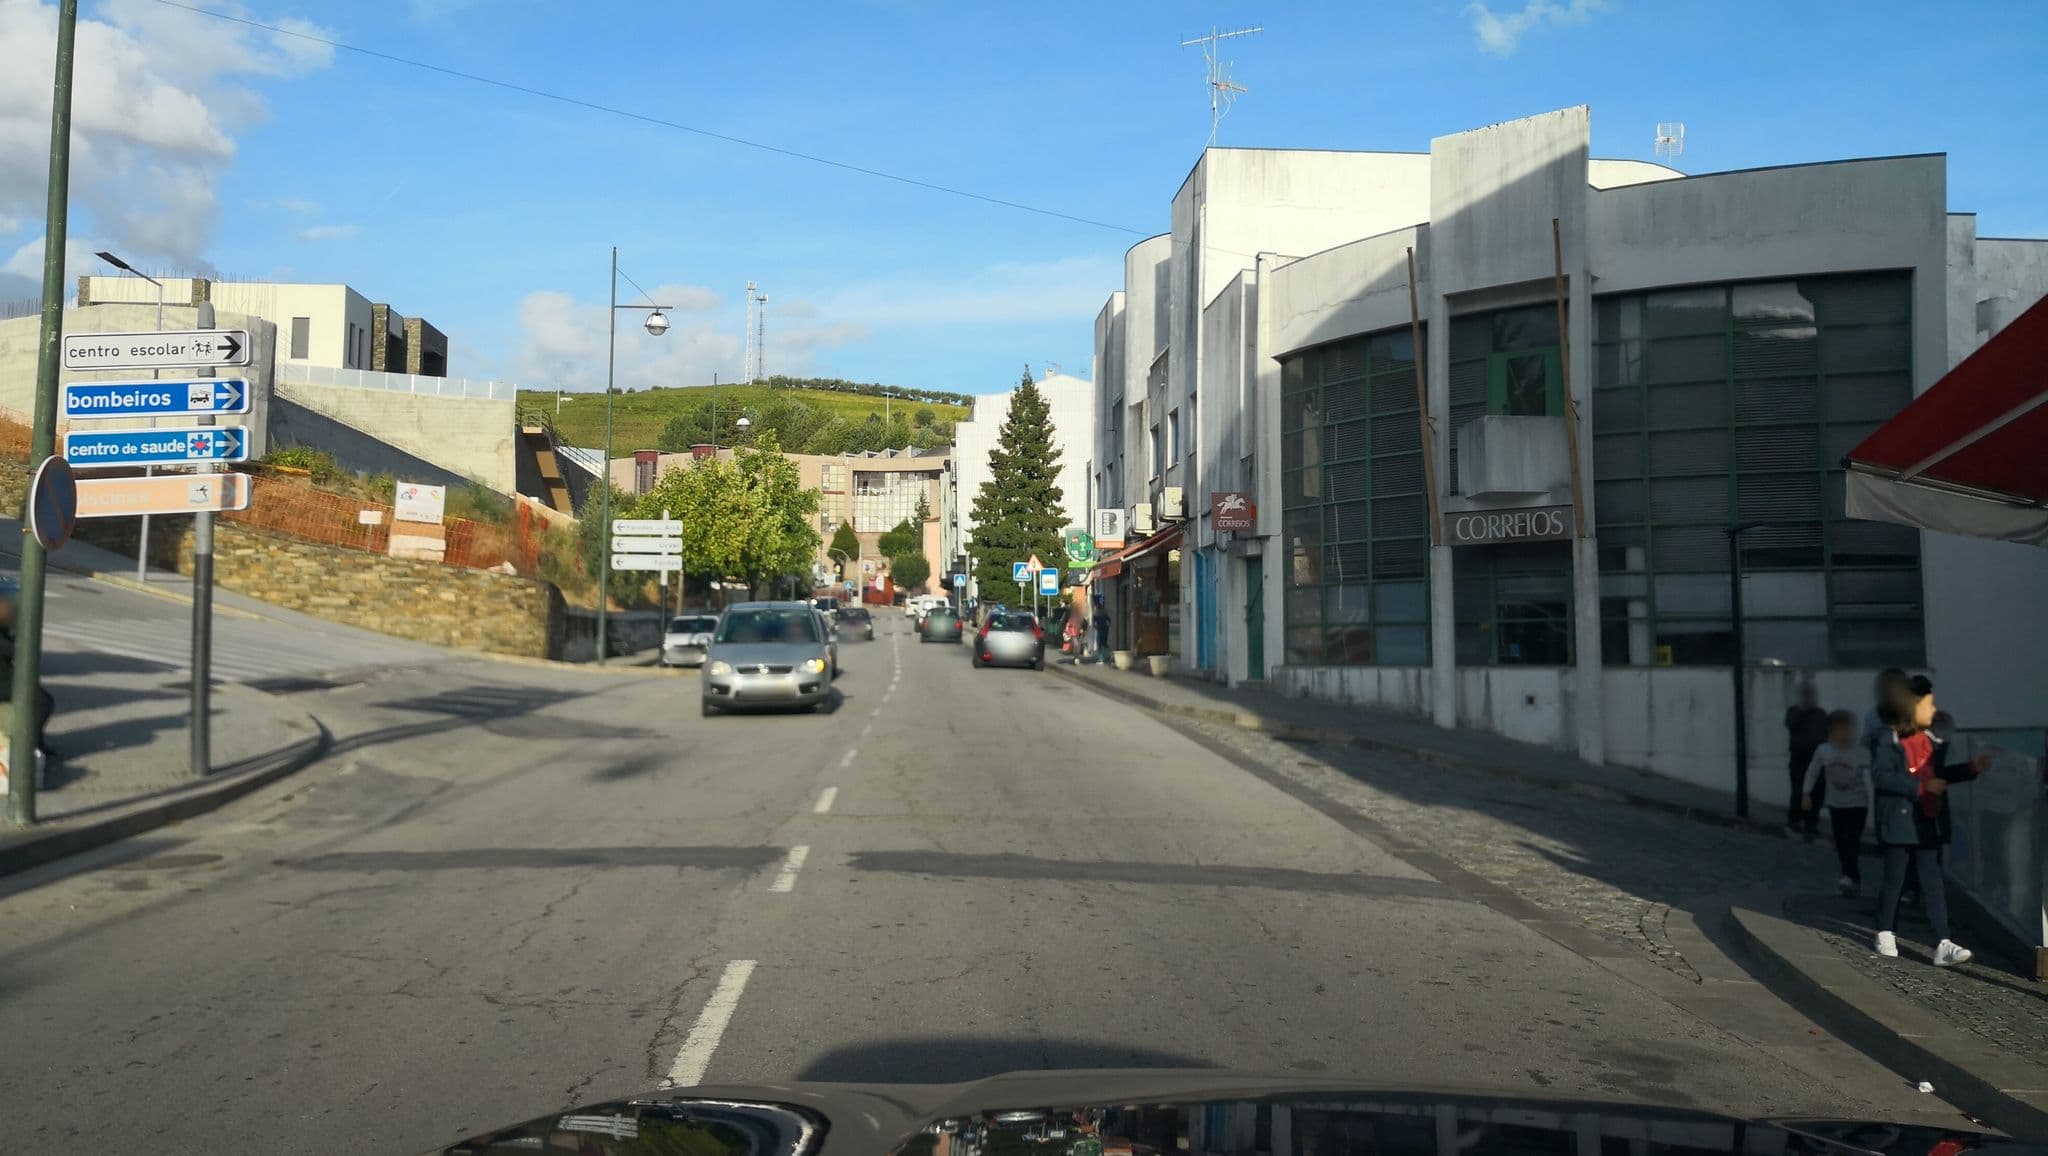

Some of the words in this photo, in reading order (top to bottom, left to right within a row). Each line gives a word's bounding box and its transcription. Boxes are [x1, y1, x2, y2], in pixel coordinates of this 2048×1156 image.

[69, 345, 120, 358] centro
[130, 343, 187, 356] escolar
[68, 390, 172, 409] bombeiros
[69, 442, 120, 456] centro
[122, 443, 138, 455] de
[140, 439, 186, 454] saude
[1456, 511, 1564, 540] CORREIOS
